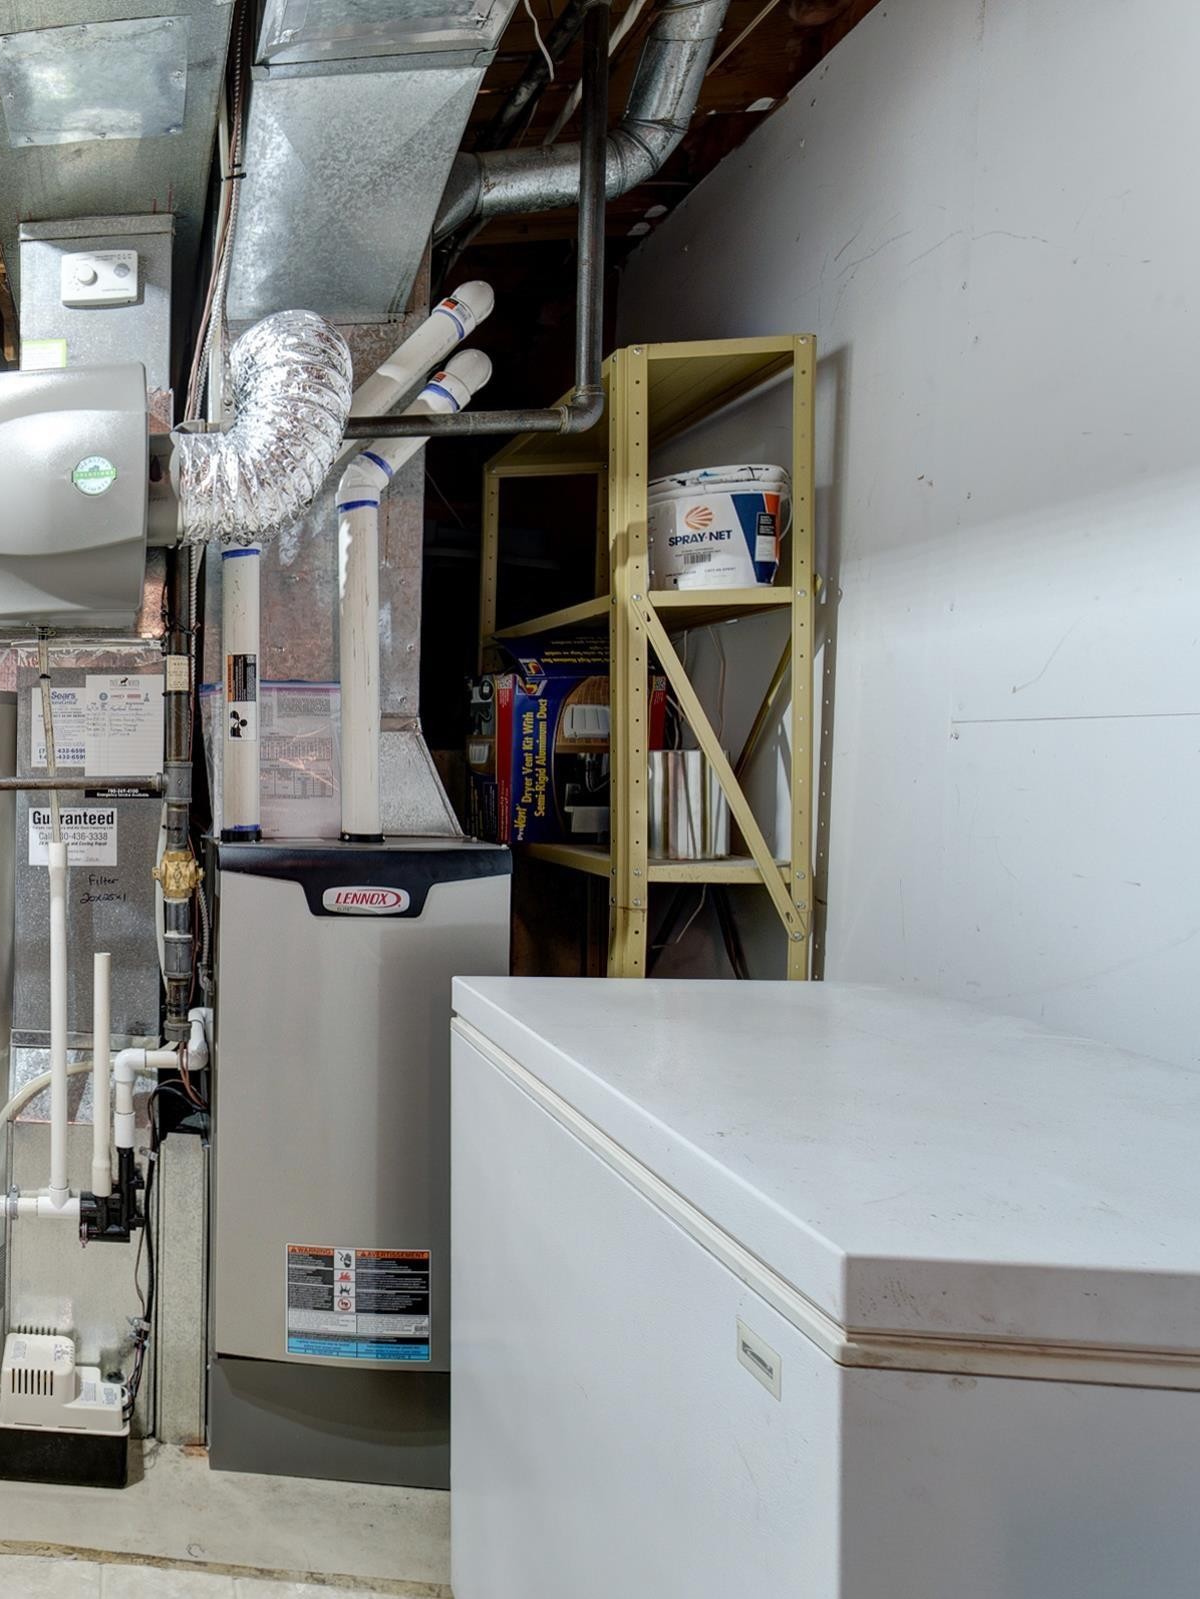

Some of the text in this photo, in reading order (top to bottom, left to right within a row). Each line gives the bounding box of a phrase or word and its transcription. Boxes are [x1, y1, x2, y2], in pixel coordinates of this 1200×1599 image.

[51, 691, 76, 700] Sears
[522, 712, 534, 735] With
[522, 737, 534, 751] Kit
[522, 753, 534, 774] Vent
[535, 698, 549, 817] Semi-Rigid Aluminum Duct
[522, 776, 534, 804] Dryer
[33, 811, 114, 825] Guranteed
[335, 891, 389, 905] LENNOX
